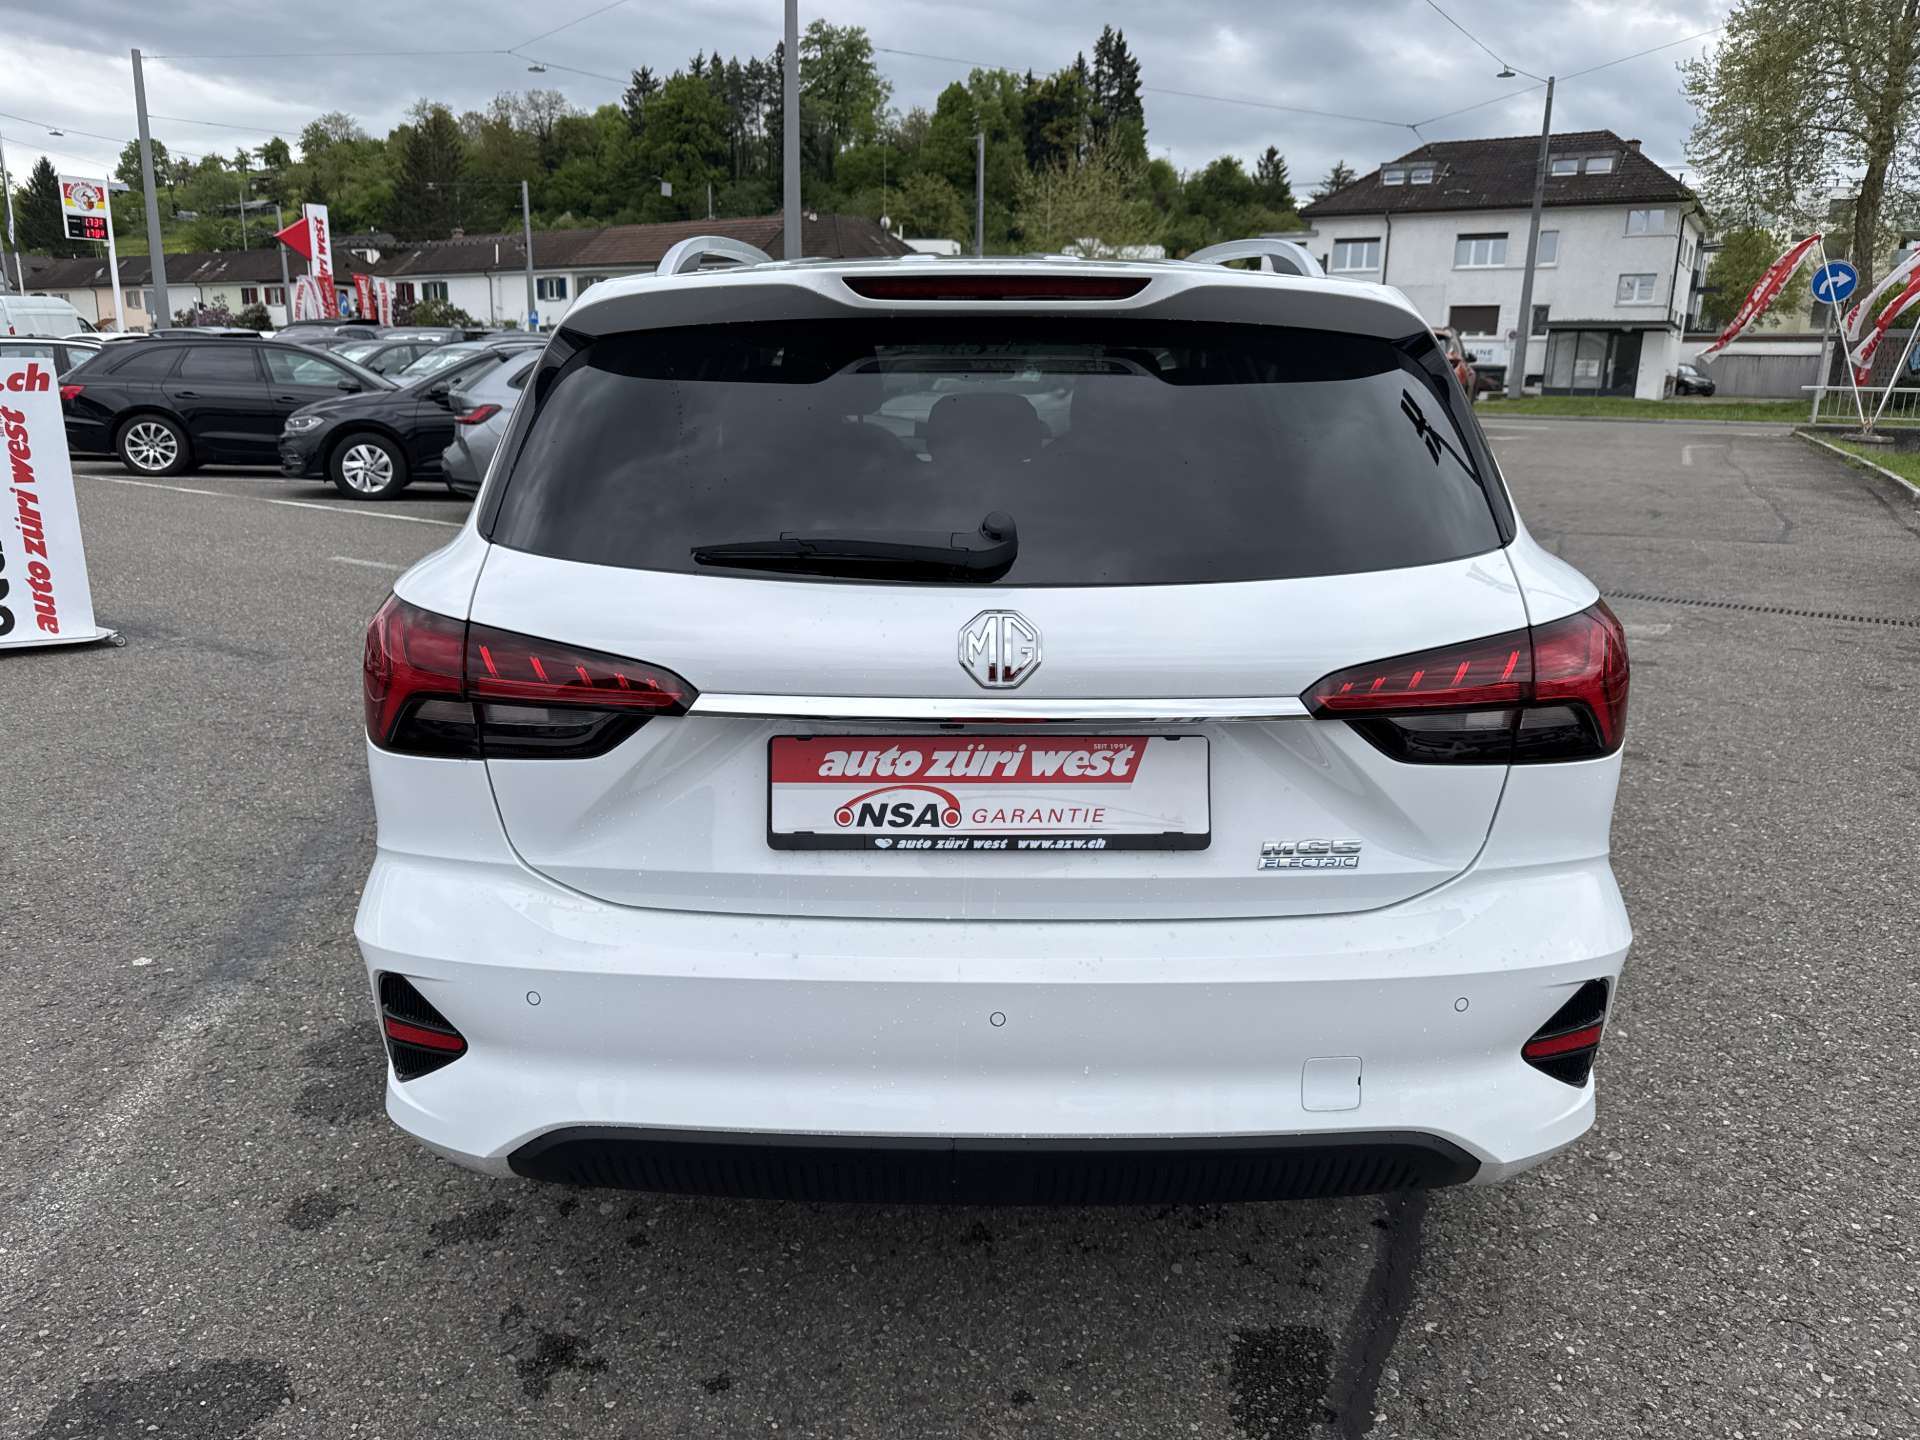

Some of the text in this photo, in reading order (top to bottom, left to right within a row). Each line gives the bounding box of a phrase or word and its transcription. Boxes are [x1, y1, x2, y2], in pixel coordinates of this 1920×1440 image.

[314, 216, 328, 255] west
[0, 405, 60, 635] auto züri west
[966, 615, 1034, 682] MG
[818, 743, 1136, 777] auto züri west
[856, 803, 1106, 828] NSA GARANTIE
[897, 837, 1106, 849] auto züri west www.azw.ch
[1258, 856, 1360, 870] ELECTRIC
